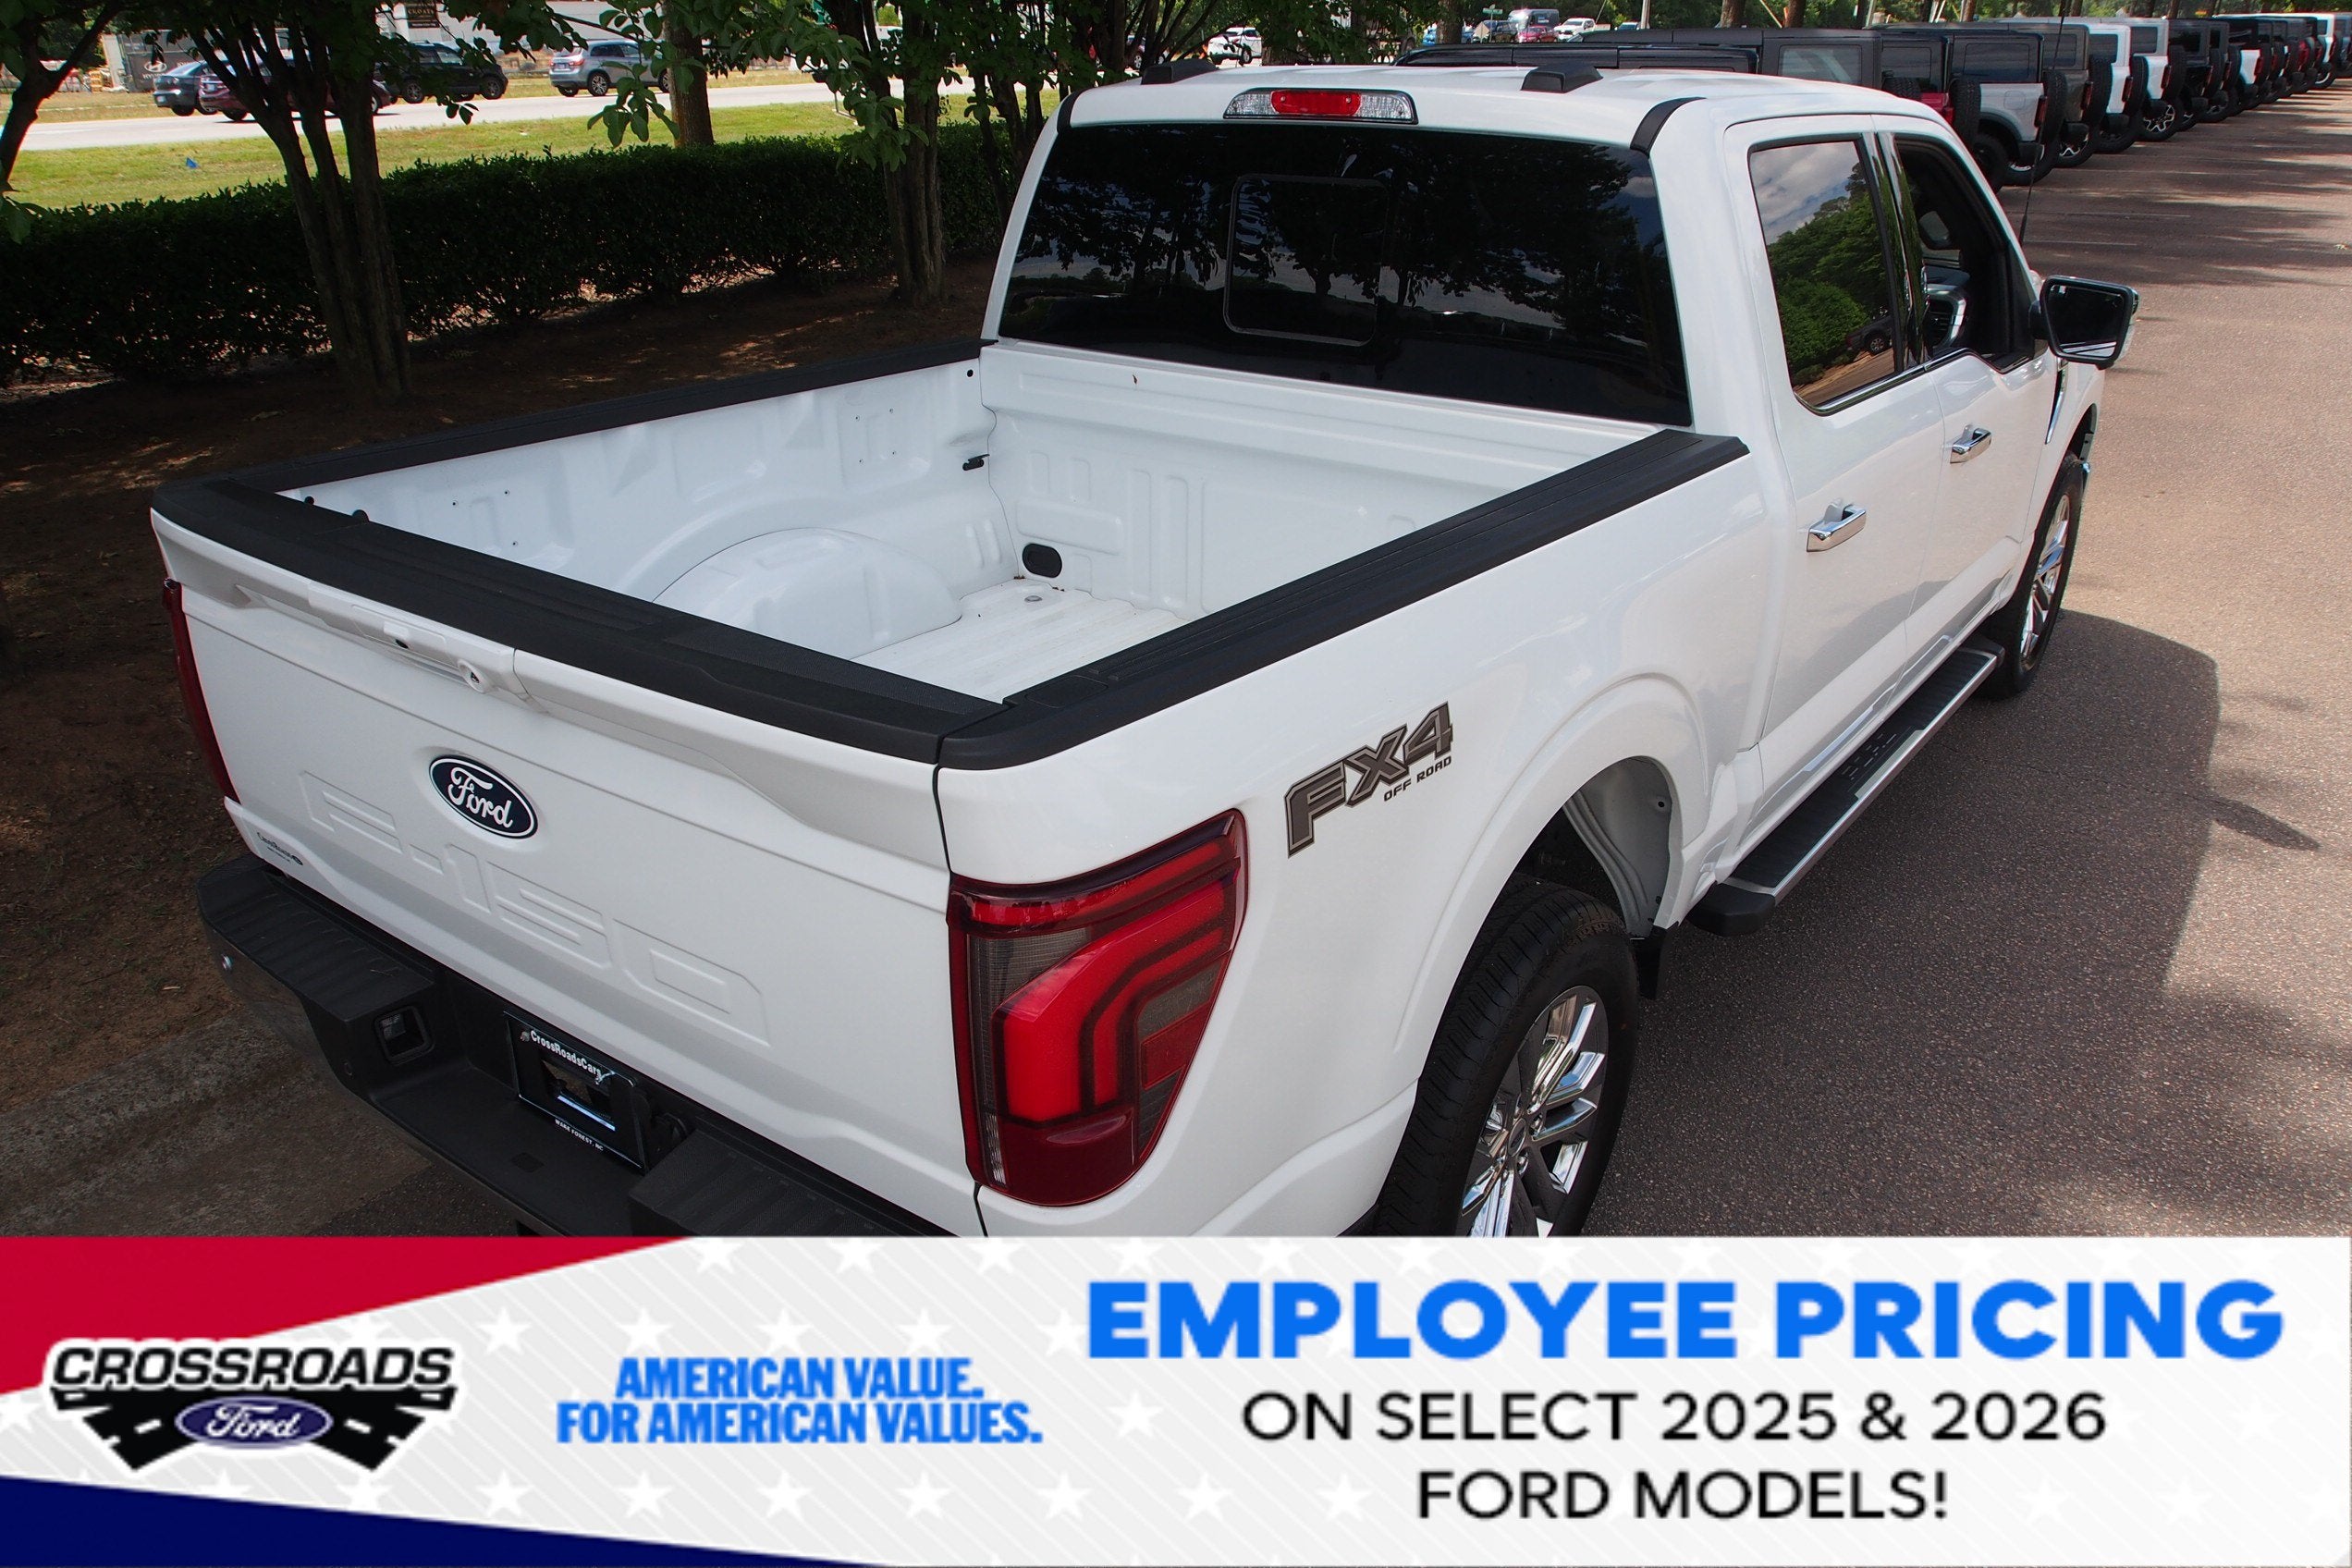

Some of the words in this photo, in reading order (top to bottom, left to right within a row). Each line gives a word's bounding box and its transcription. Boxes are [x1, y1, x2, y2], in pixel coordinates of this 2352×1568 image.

[447, 766, 514, 828] Ford
[1283, 700, 1453, 859] FX4
[1383, 778, 1412, 802] OFF
[1416, 755, 1452, 784] ROAD
